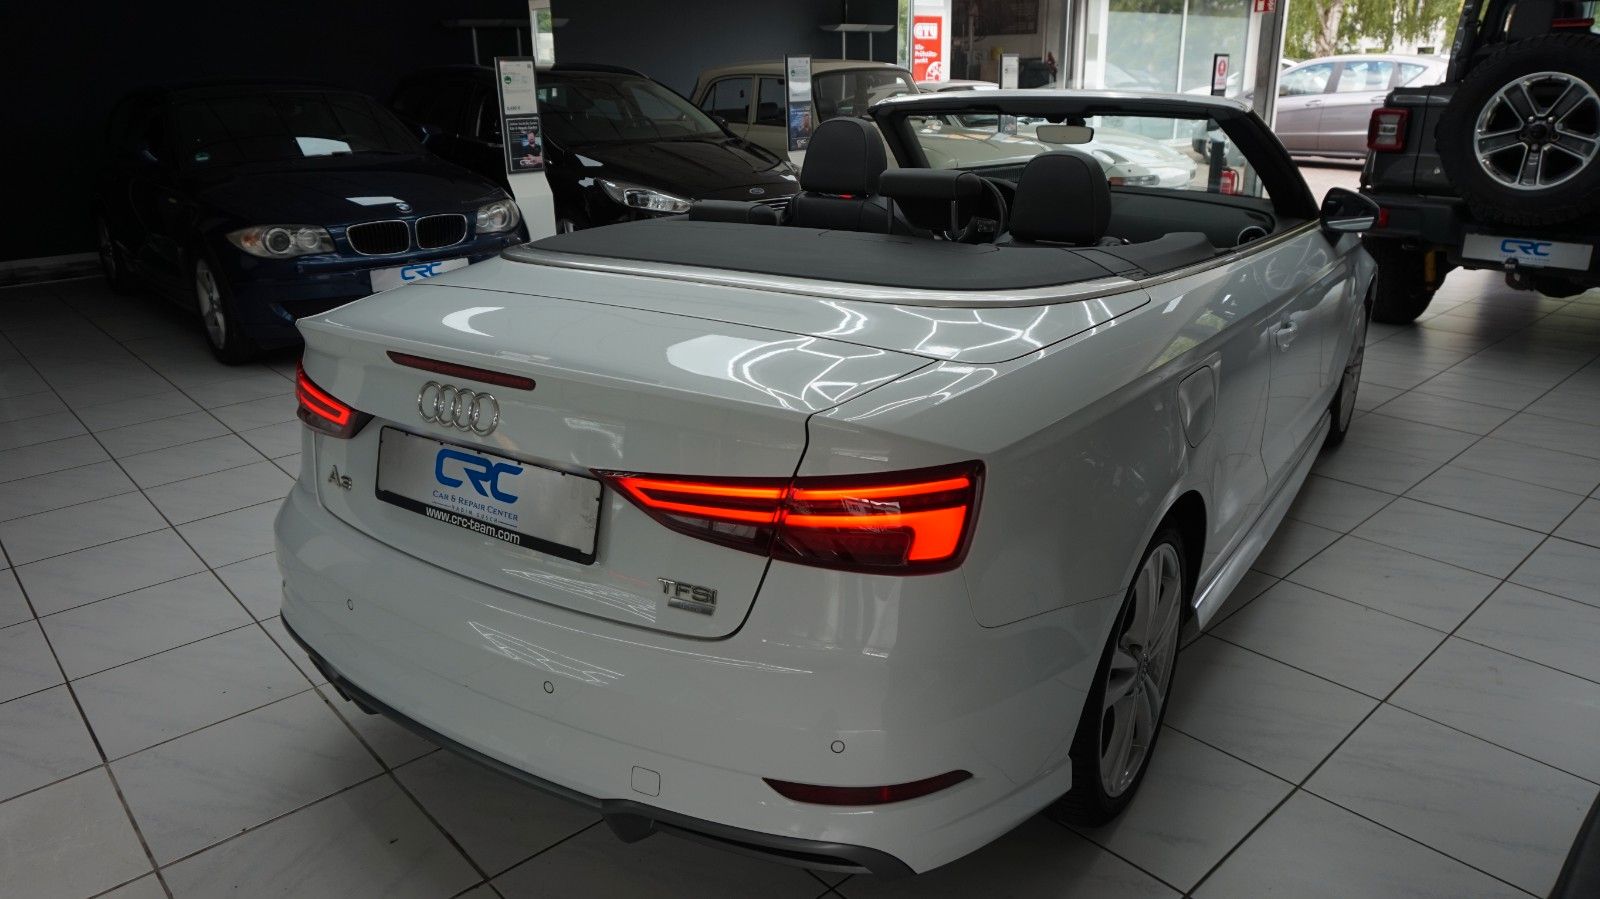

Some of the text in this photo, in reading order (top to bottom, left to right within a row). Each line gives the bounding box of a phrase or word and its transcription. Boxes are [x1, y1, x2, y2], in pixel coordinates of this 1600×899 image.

[1500, 238, 1553, 257] CRC
[400, 262, 442, 281] CRC
[328, 464, 353, 491] A3
[435, 448, 524, 504] CRC
[458, 496, 487, 512] REPAIR
[487, 505, 519, 522] CENTER
[426, 506, 521, 545] www.crc-team.com
[657, 577, 718, 604] TFSI
